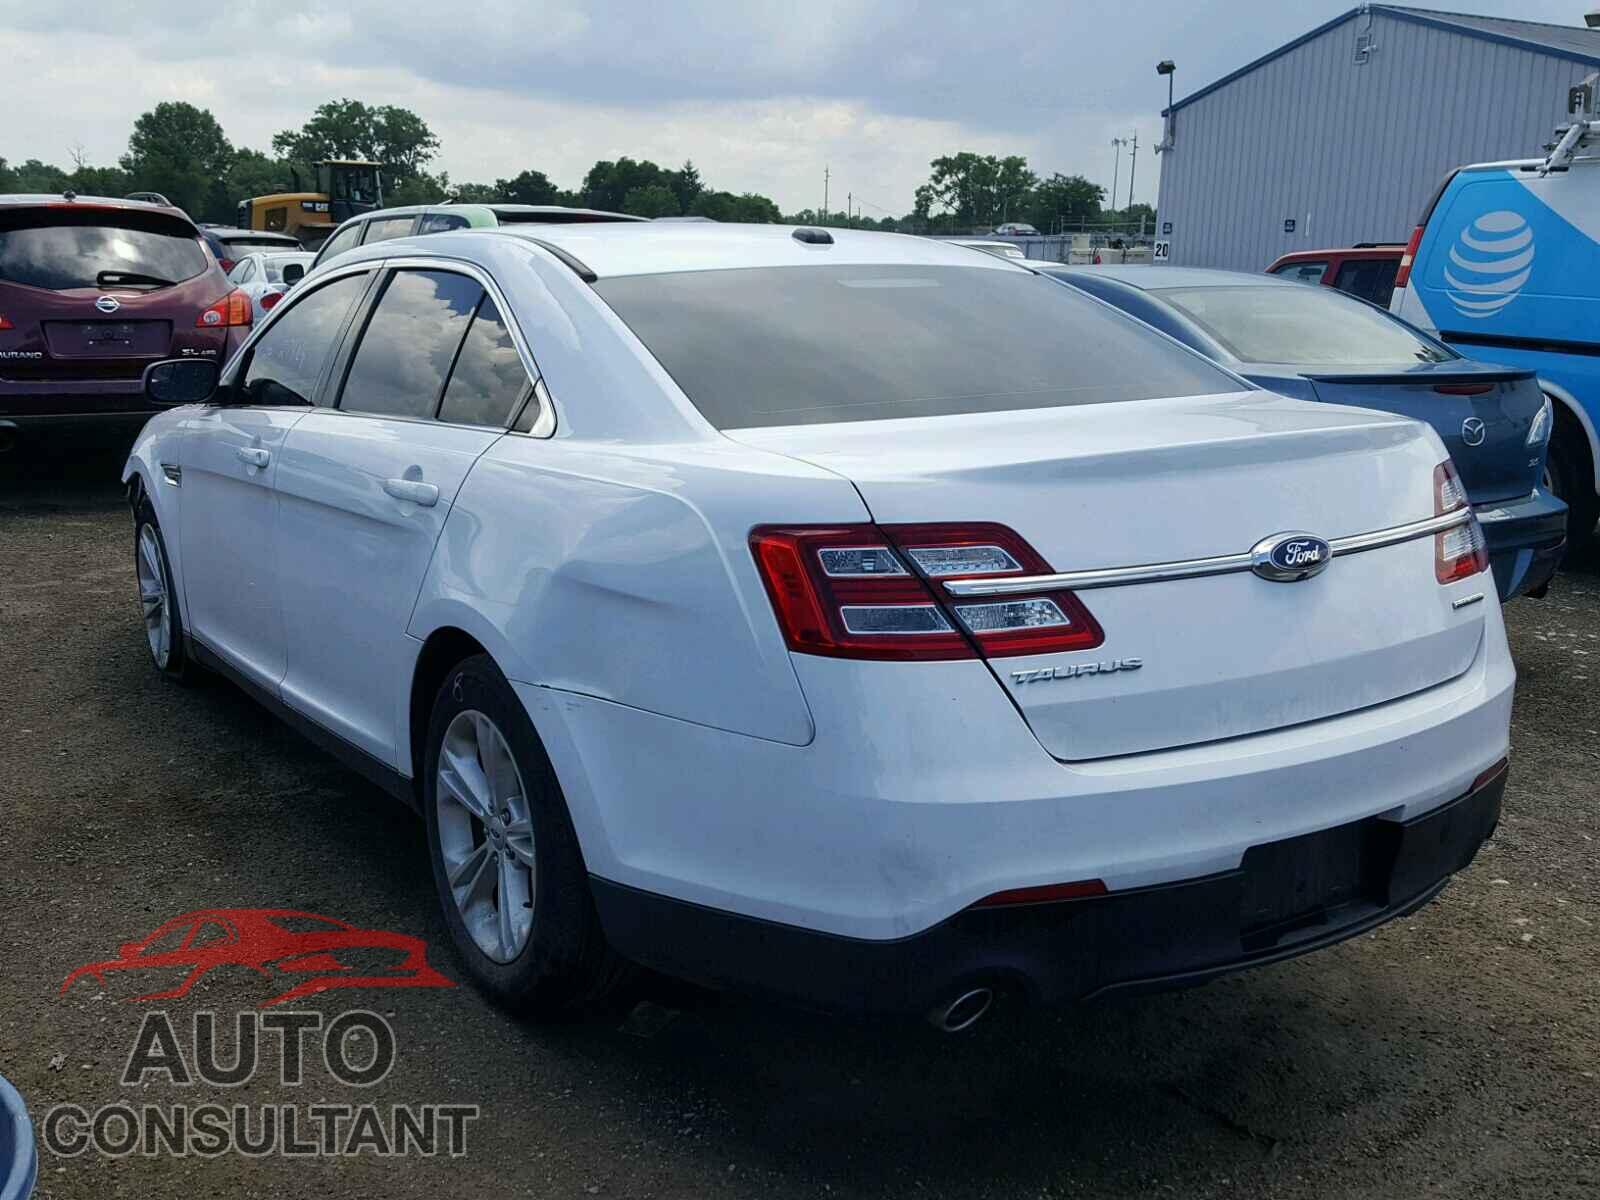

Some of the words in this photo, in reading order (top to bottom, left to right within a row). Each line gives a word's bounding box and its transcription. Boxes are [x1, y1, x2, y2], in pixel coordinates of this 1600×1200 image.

[315, 202, 329, 211] CAT
[1155, 243, 1169, 257] 20
[181, 348, 200, 356] SL
[1285, 541, 1320, 565] Ford
[1010, 657, 1143, 685] TAURUS
